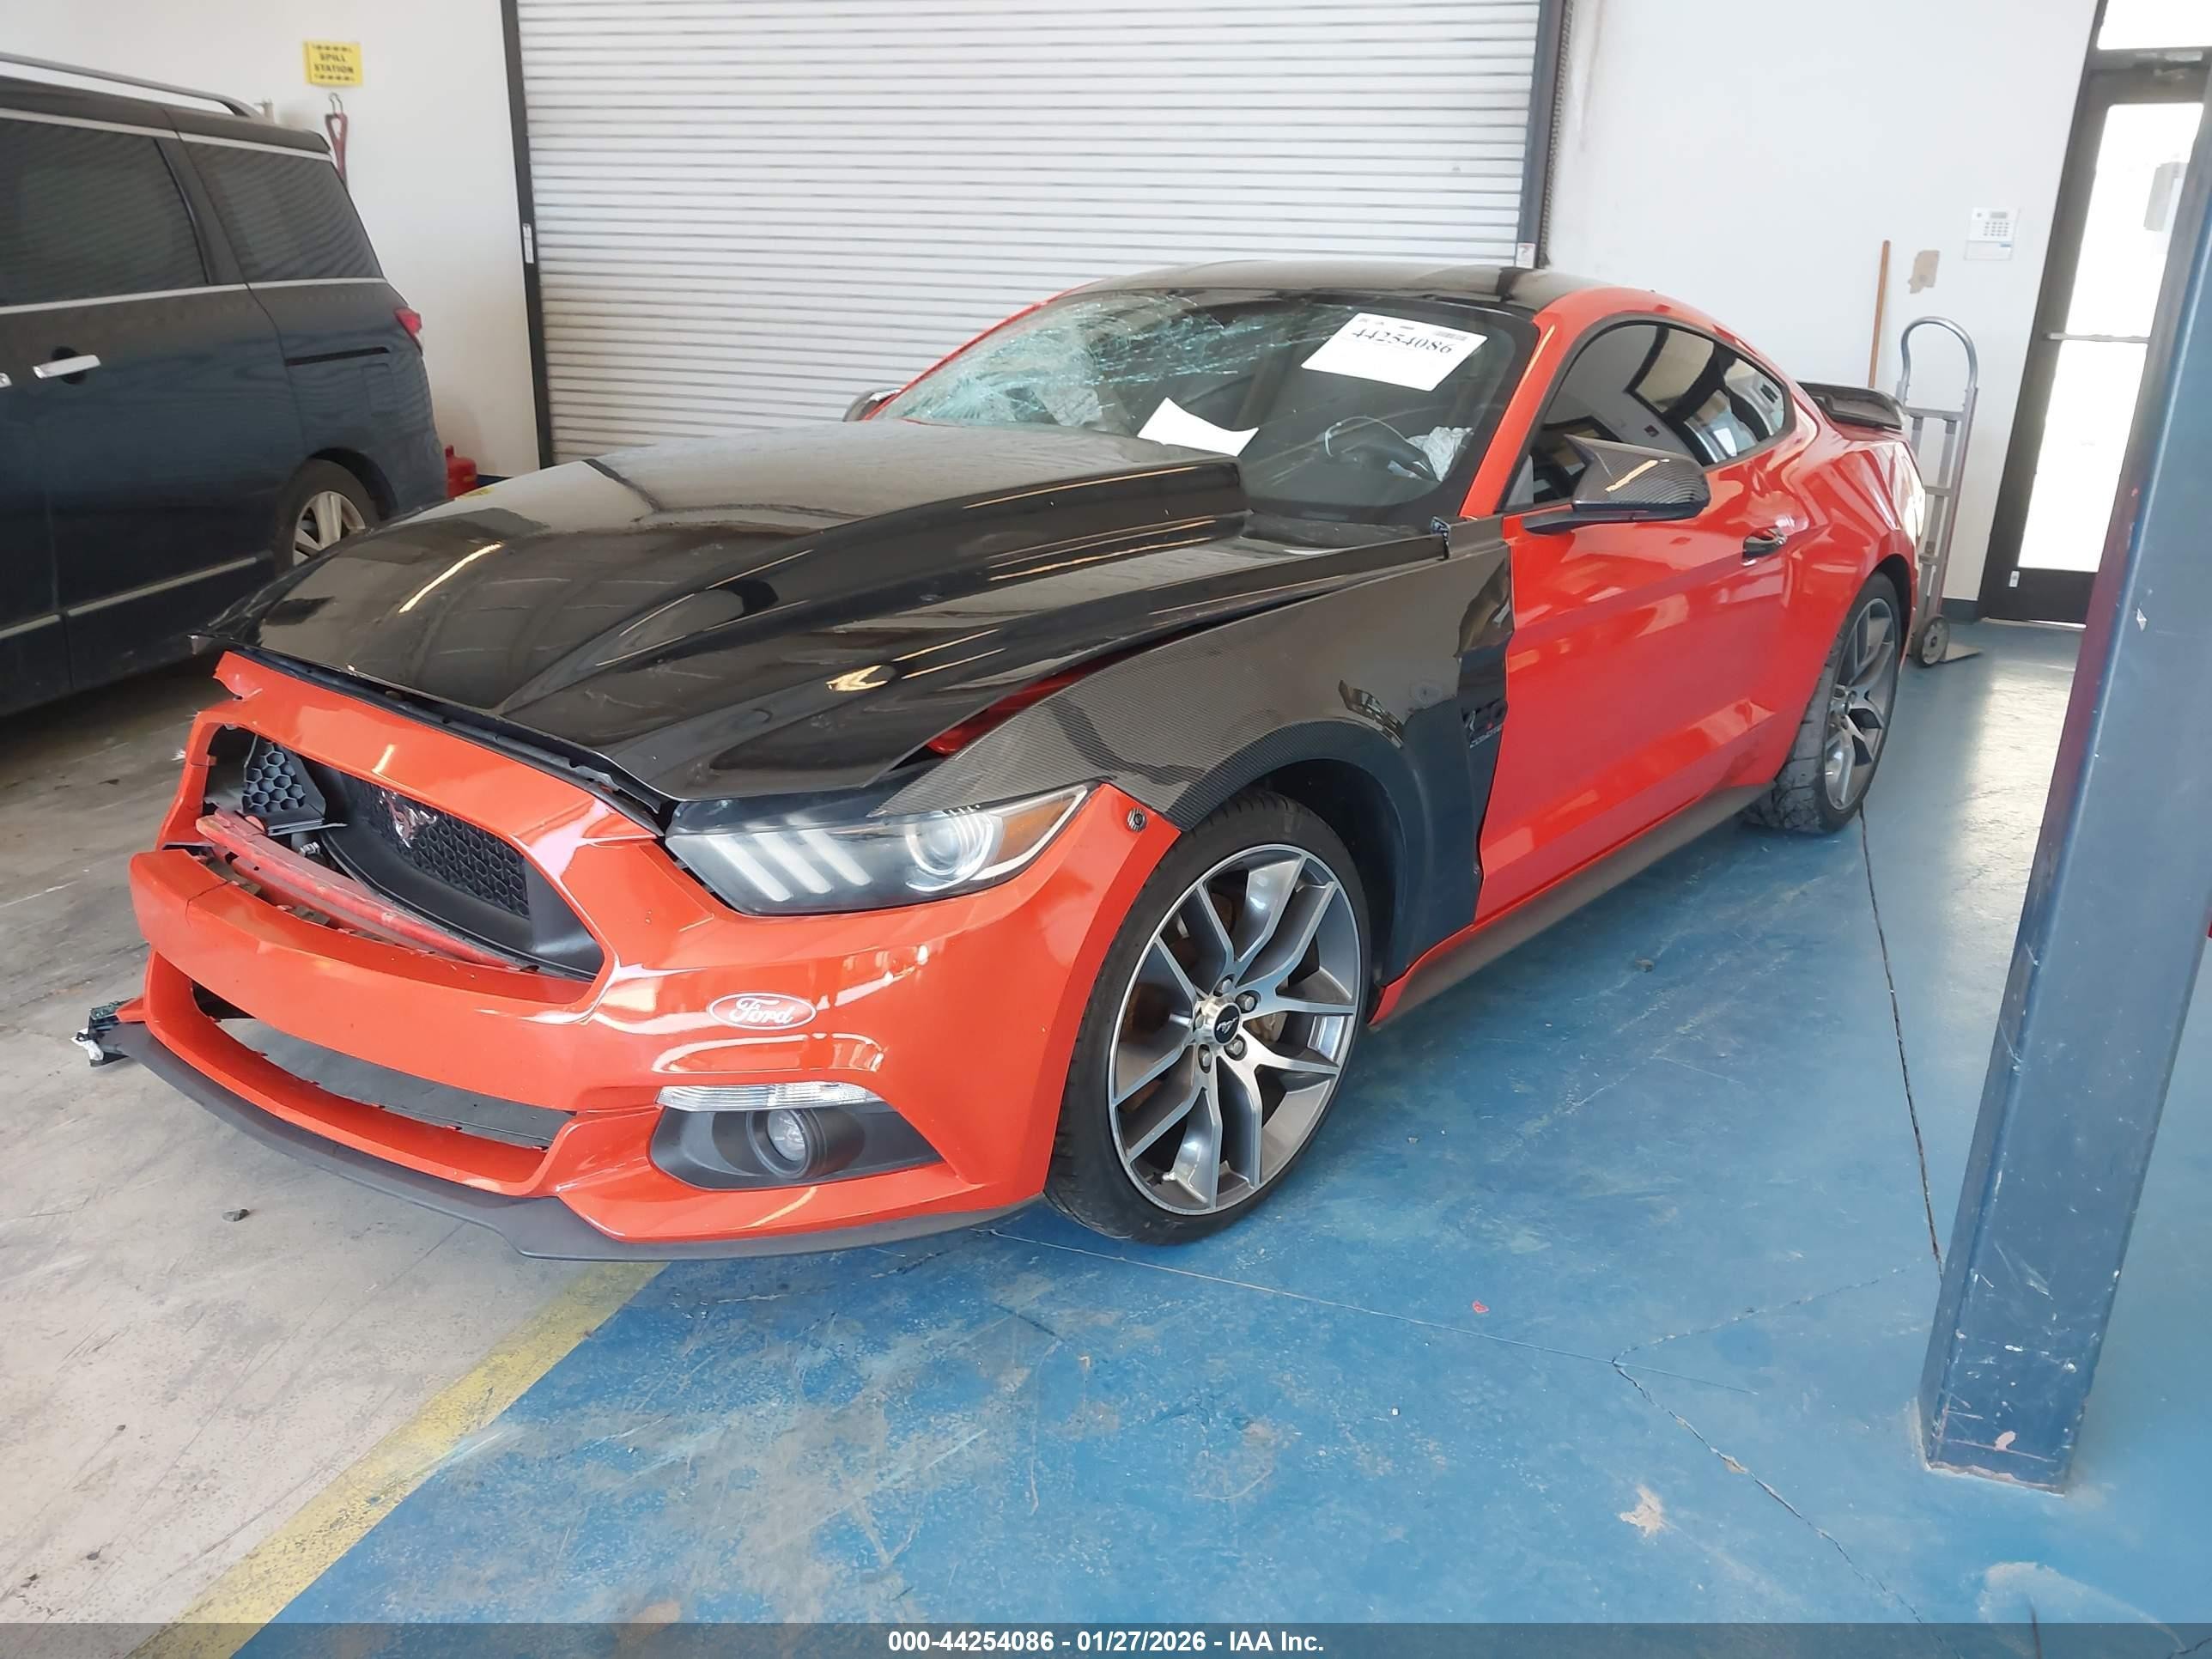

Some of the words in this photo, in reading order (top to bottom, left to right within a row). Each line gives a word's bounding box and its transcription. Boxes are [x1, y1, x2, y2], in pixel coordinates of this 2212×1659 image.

[319, 52, 346, 63] SPILL
[313, 63, 354, 75] STATION
[1352, 328, 1453, 354] 44254086
[729, 997, 795, 1024] Ford
